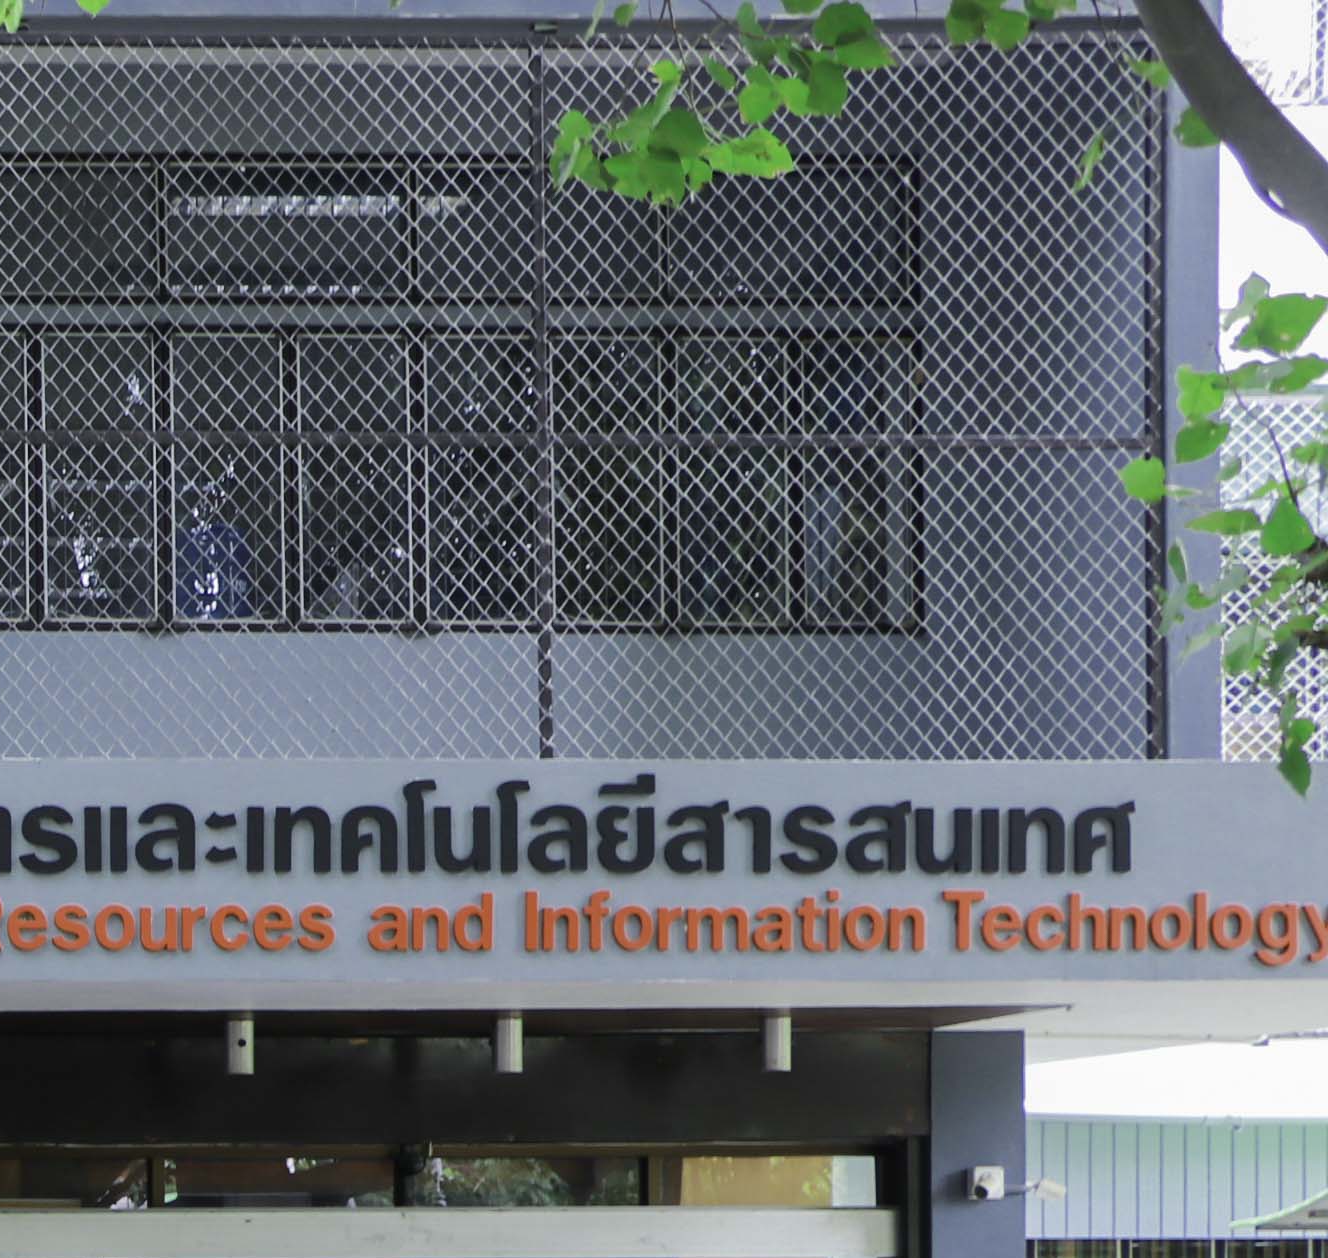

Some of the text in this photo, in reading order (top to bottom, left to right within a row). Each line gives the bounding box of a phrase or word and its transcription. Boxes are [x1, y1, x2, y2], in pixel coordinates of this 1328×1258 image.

[368, 892, 494, 952] and
[524, 890, 925, 953] Information
[943, 890, 1328, 966] Technology
